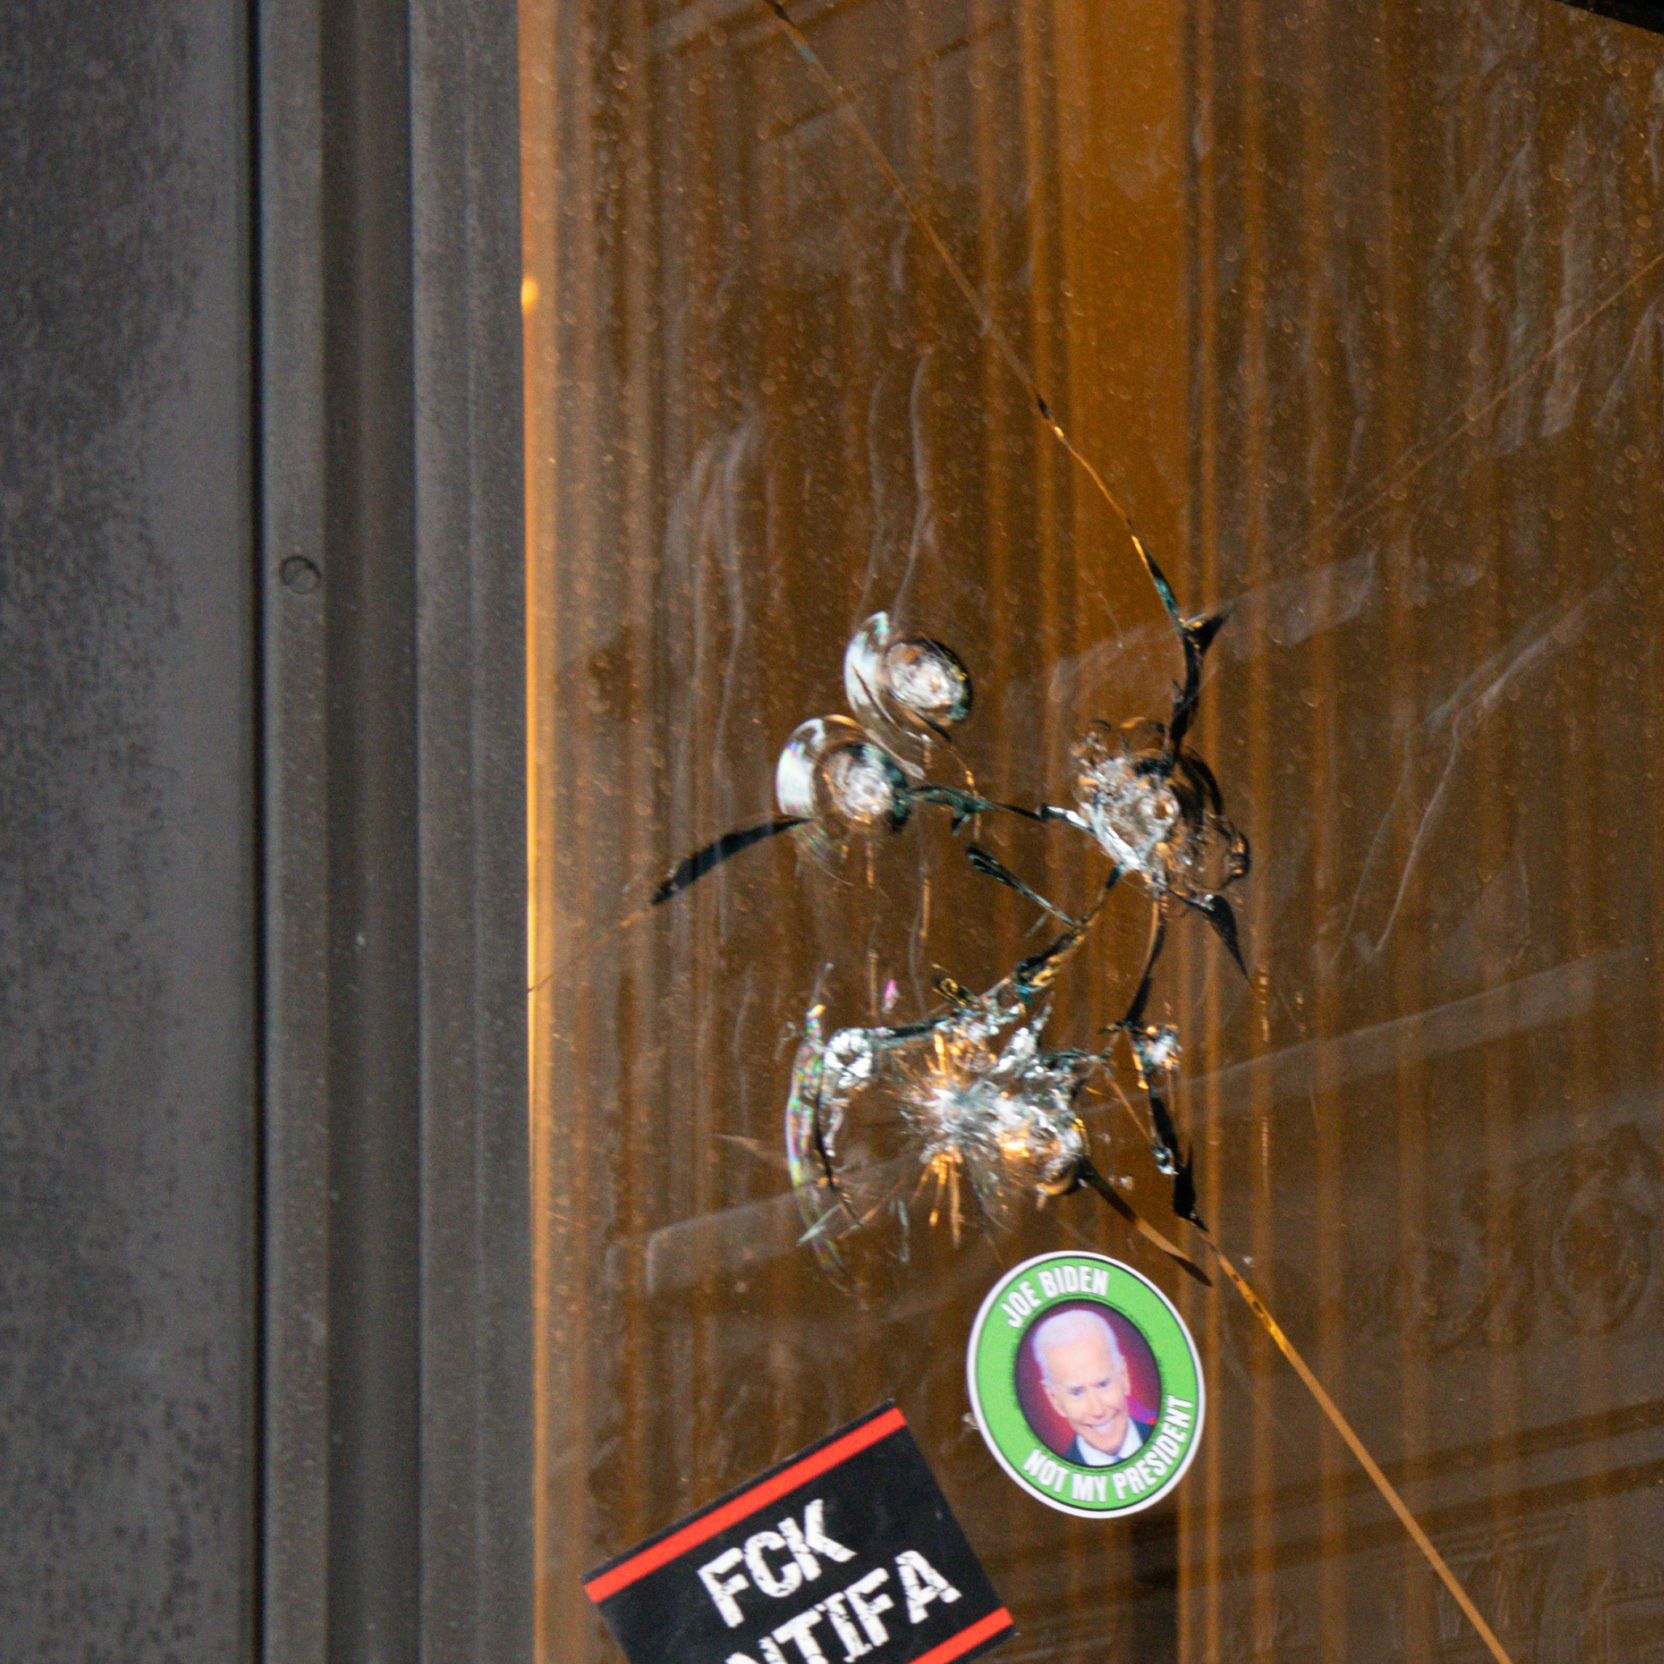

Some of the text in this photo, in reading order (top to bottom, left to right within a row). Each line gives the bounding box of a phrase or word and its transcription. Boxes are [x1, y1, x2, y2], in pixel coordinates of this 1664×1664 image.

[999, 1265, 1109, 1328] JOE BIDEN
[1022, 1395, 1193, 1502] NOT MY PRESIDENT
[697, 1499, 857, 1628] FCK
